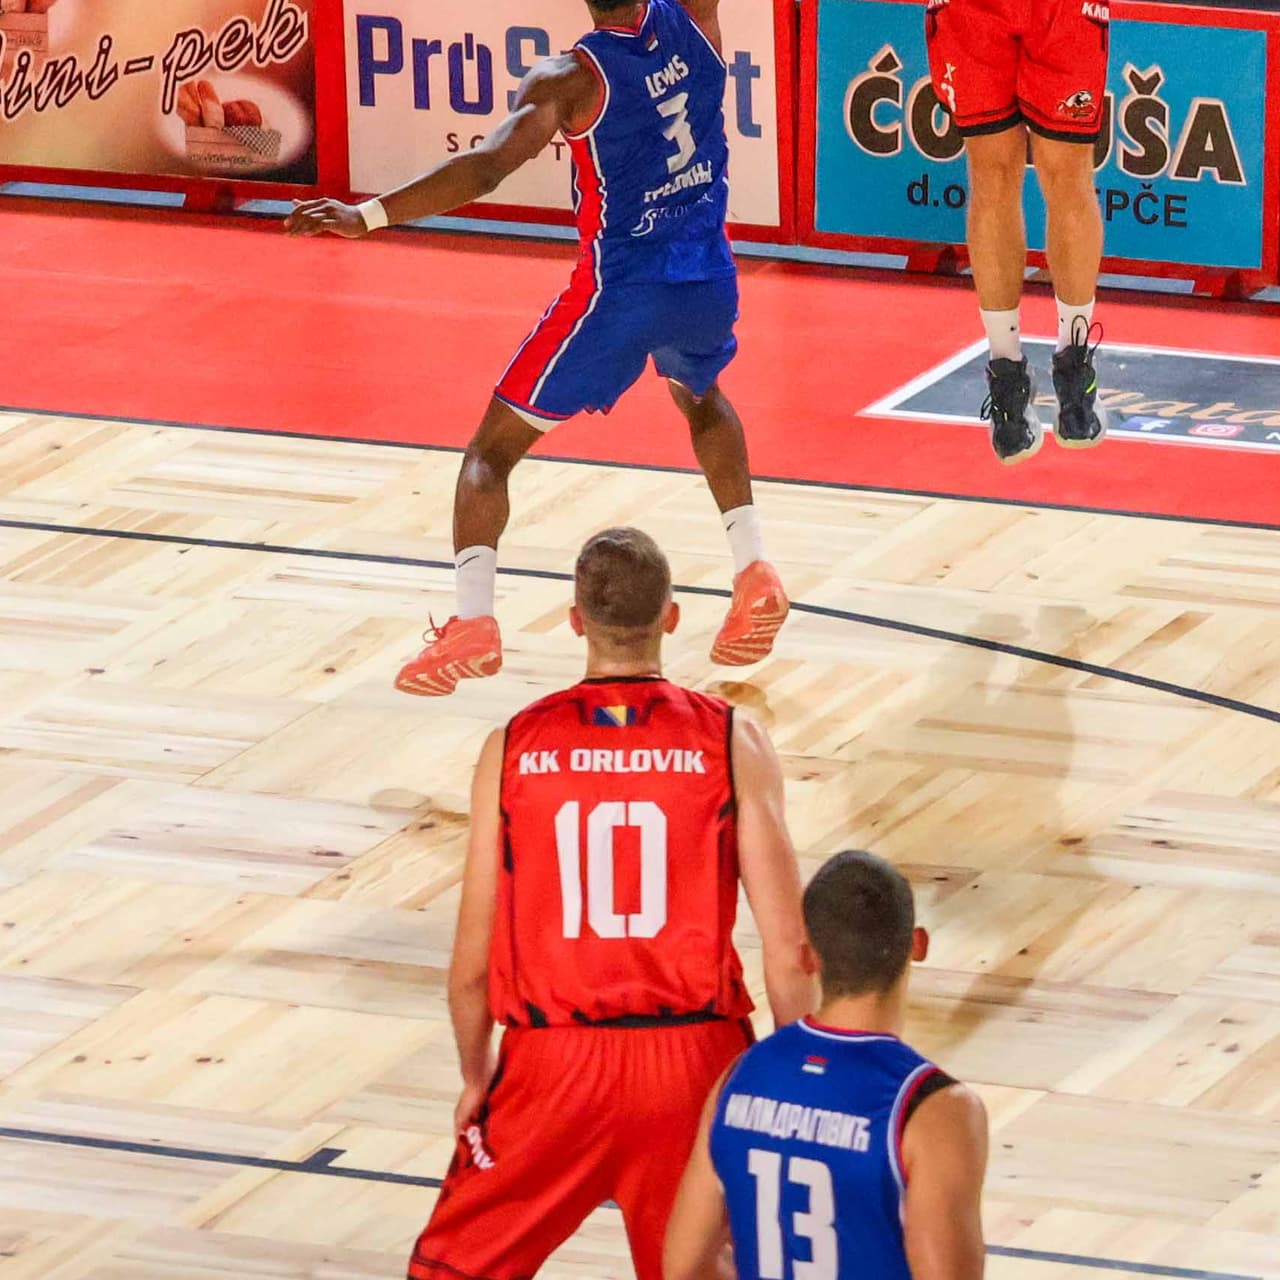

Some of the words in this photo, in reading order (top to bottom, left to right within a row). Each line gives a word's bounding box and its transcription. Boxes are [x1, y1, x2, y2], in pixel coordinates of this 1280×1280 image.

[655, 91, 697, 174] 3
[519, 749, 561, 776] KK
[569, 747, 706, 776] ORLOVIK
[554, 800, 668, 940] 10
[748, 1149, 838, 1280] 13
